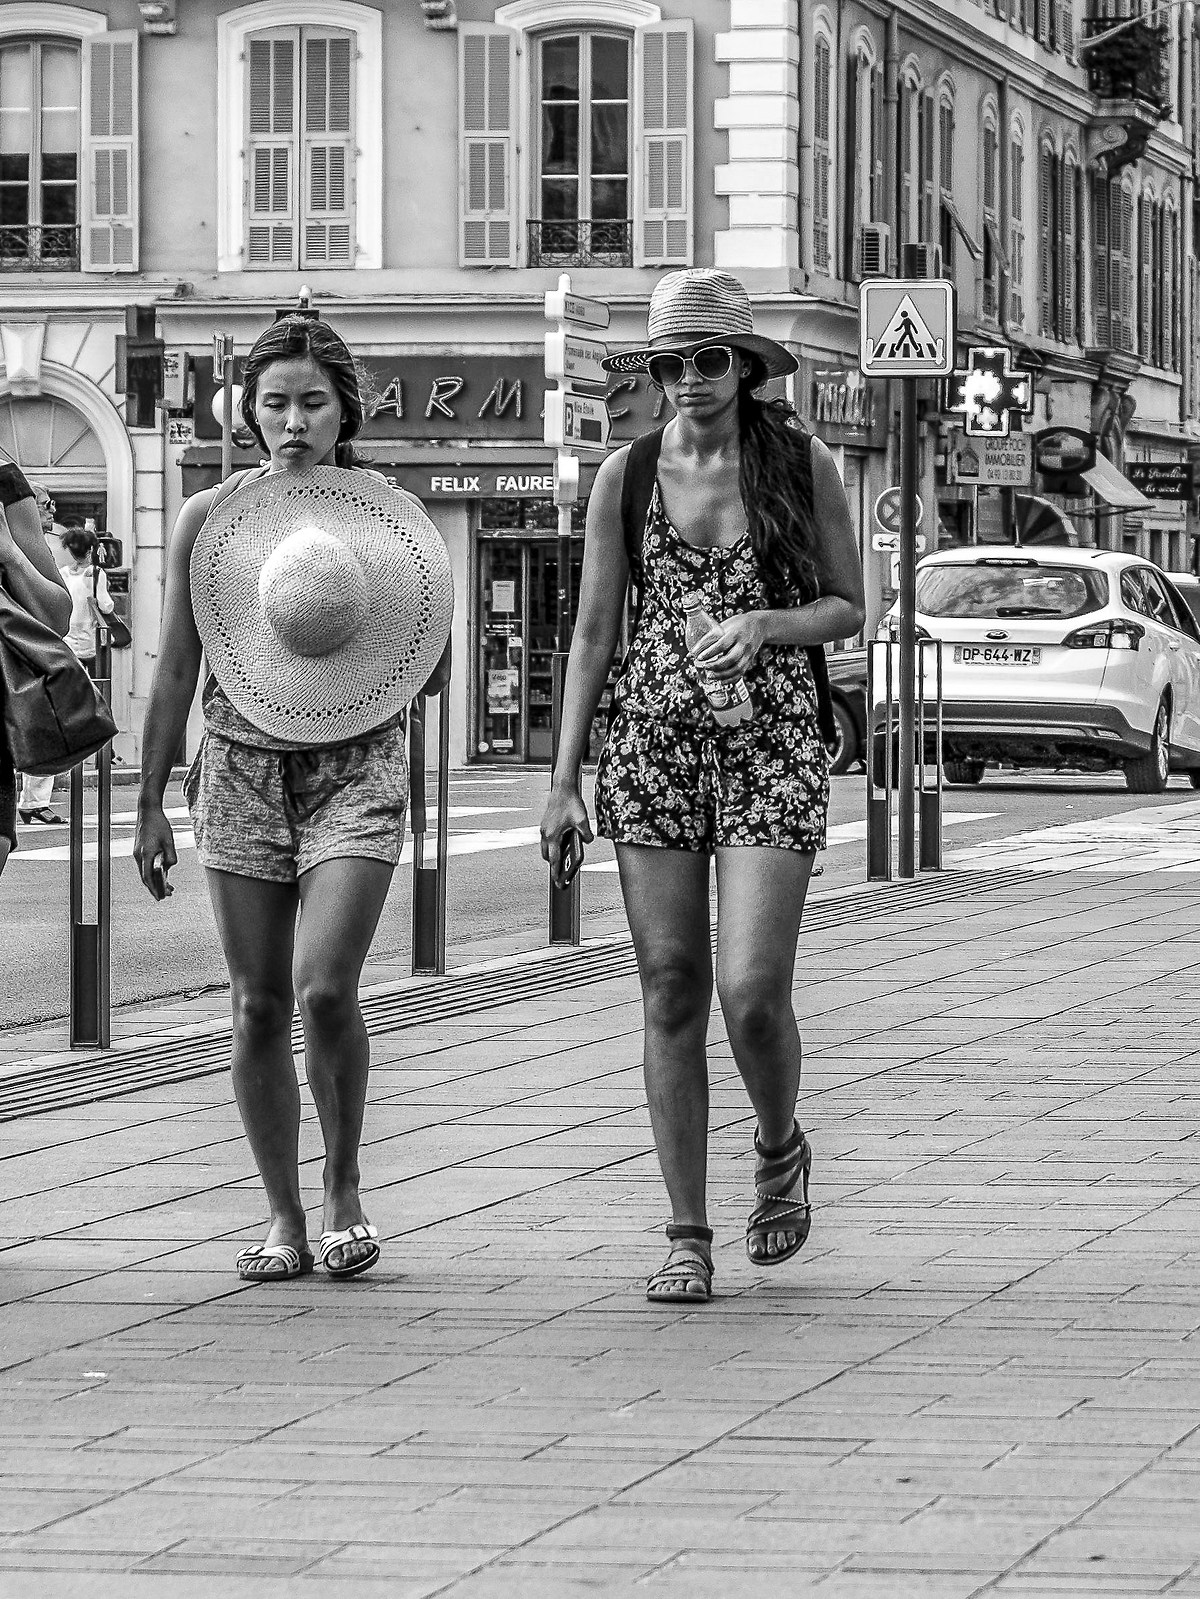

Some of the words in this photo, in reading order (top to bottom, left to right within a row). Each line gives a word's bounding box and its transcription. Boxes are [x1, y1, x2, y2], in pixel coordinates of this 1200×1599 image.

[431, 476, 480, 491] FELIX
[496, 475, 554, 491] FAURE
[962, 647, 1032, 662] DP-644-WZ
